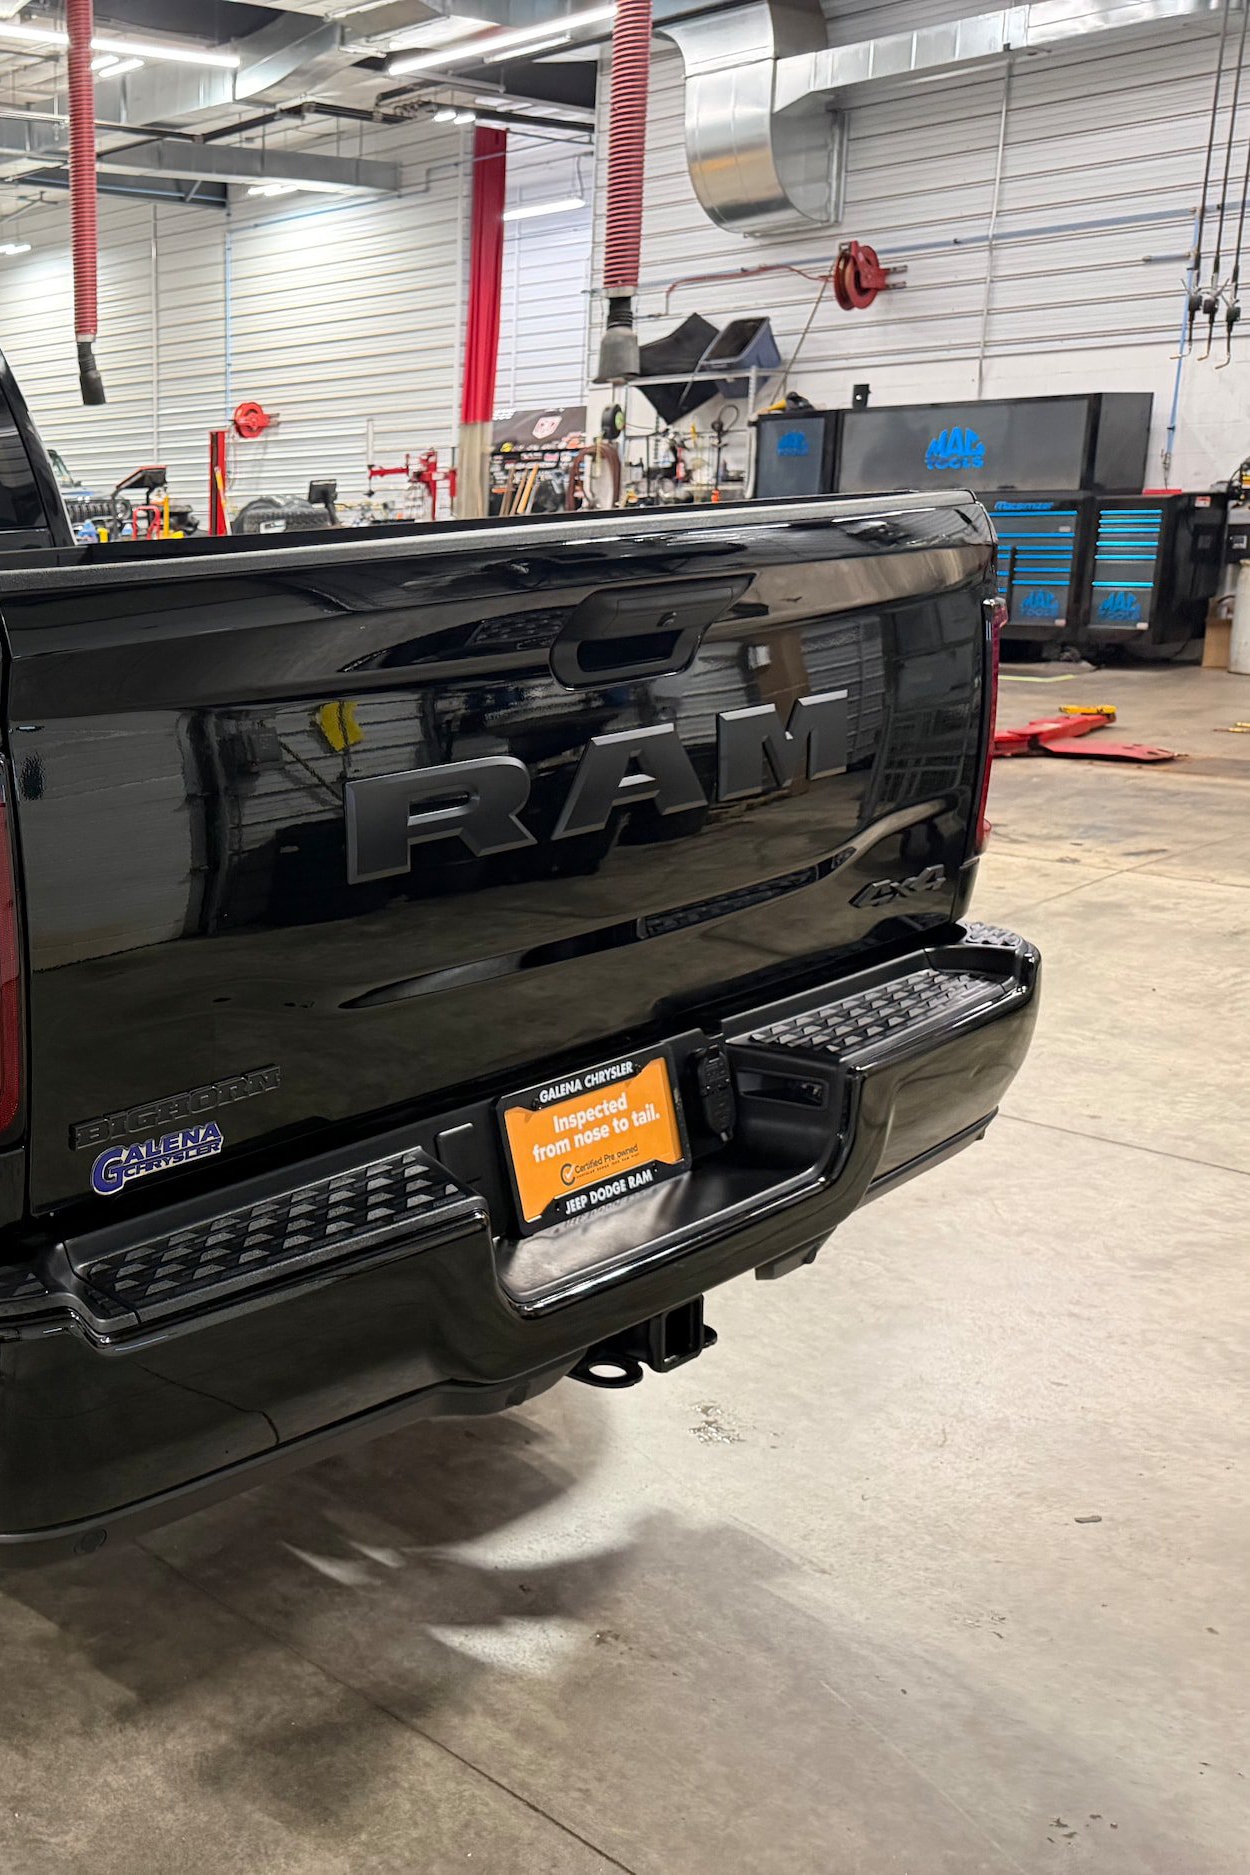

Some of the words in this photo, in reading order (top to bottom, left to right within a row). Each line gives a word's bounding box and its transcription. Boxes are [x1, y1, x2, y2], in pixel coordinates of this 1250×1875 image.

[925, 427, 986, 458] MAC
[343, 689, 848, 885] RAM
[539, 1078, 583, 1104] GALENA
[584, 1060, 634, 1088] CHRYSLER
[532, 1140, 571, 1162] from
[574, 1126, 610, 1149] nose
[612, 1119, 629, 1135] to
[631, 1103, 660, 1129] tail.
[553, 1092, 628, 1133] Inspected
[91, 1120, 222, 1195] GALENA
[124, 1141, 222, 1178] CHRYSLER
[575, 1157, 603, 1174] Certified
[565, 1195, 588, 1215] JEEP
[589, 1182, 627, 1205] DODGE
[627, 1169, 653, 1190] RAM
